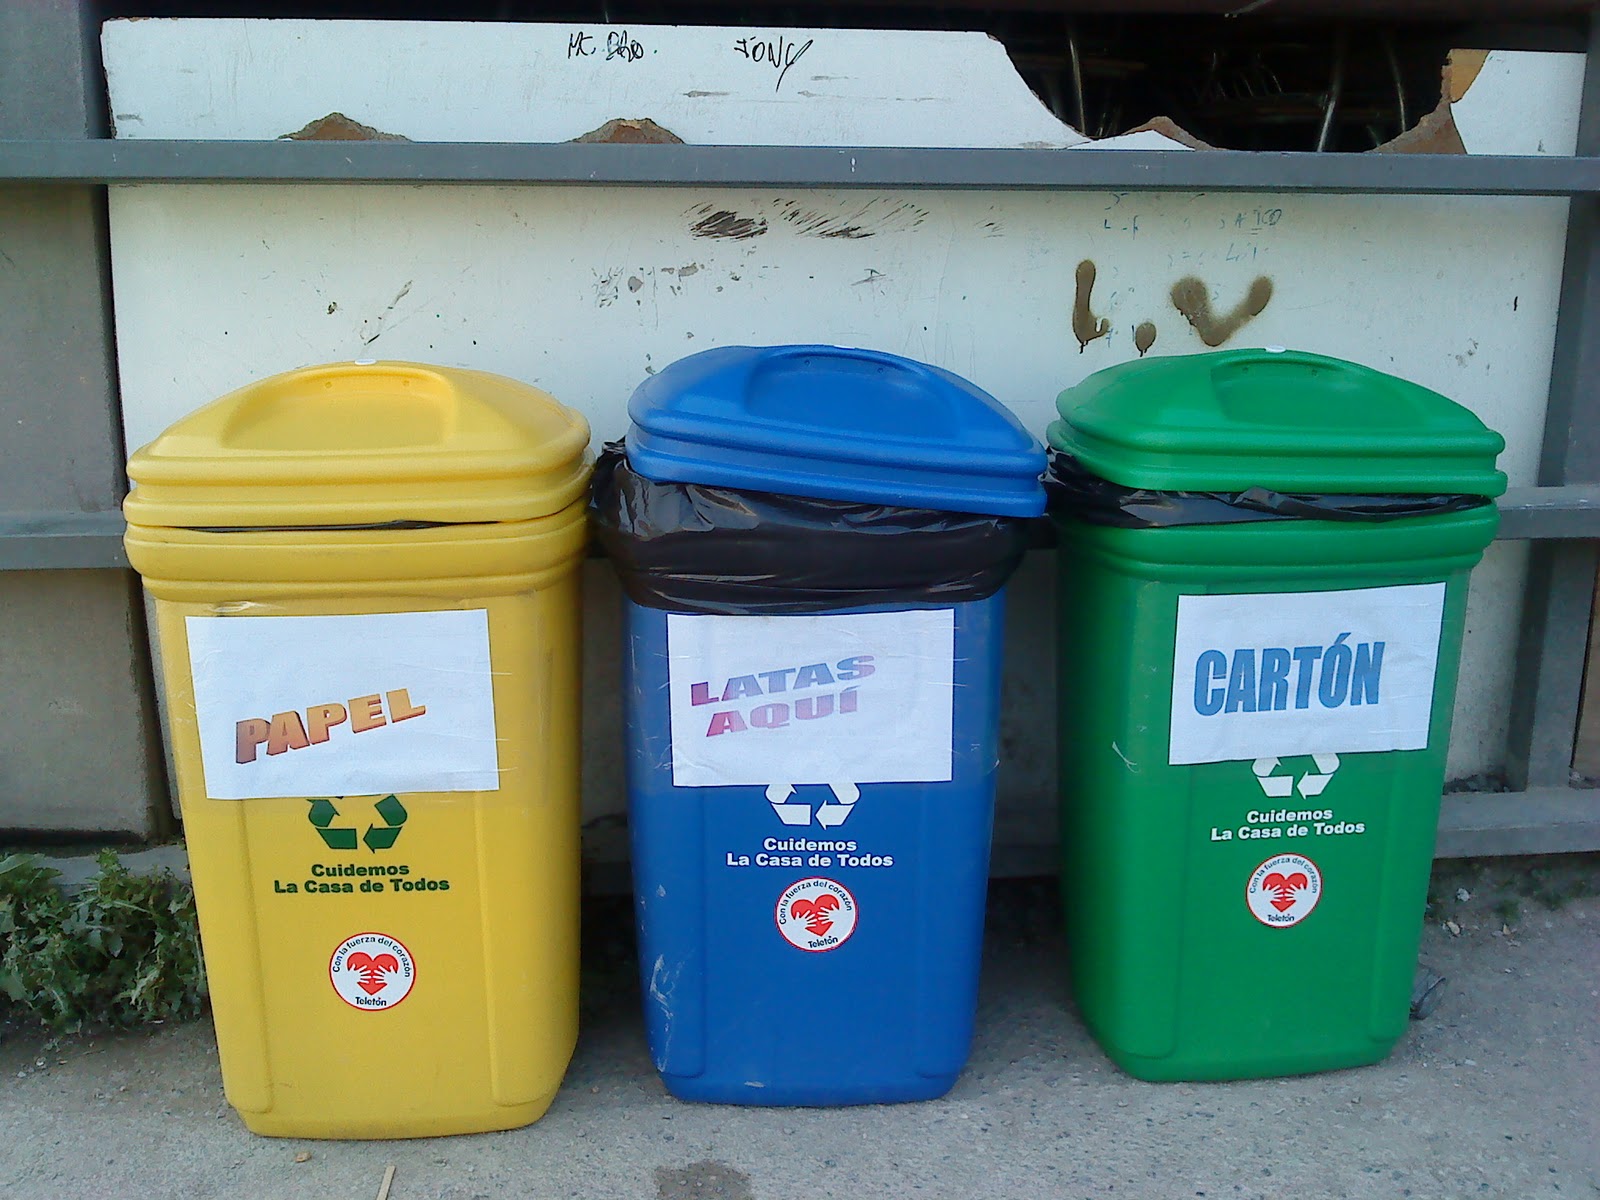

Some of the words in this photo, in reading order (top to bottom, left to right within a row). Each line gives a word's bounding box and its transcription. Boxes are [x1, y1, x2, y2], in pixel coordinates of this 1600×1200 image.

[690, 655, 876, 707] LATAS
[1193, 632, 1386, 717] CARTÓN
[706, 685, 861, 738] AQUÍ
[235, 688, 426, 764] PAPEL
[1246, 809, 1333, 823] Cuidemos
[1211, 828, 1232, 841] La
[1238, 826, 1282, 839] Casa
[1286, 824, 1308, 837] de
[1313, 821, 1365, 835] Todos
[763, 838, 857, 851] Cuidemos
[726, 853, 750, 866] La
[755, 854, 802, 866] Casa
[808, 855, 831, 867] de
[837, 854, 893, 867] Todos
[311, 864, 410, 877] Cuidemos
[1249, 876, 1260, 894] Con
[1264, 857, 1291, 870] fuerza
[1292, 857, 1306, 866] del
[1303, 863, 1319, 894] corazón
[274, 880, 298, 893] La
[304, 880, 353, 893] Casa
[360, 880, 384, 892] de
[390, 878, 450, 891] Todos
[785, 882, 812, 899] fuerza
[813, 880, 828, 888] del
[780, 899, 789, 907] la
[828, 883, 853, 911] corazón
[779, 908, 787, 925] Con
[1267, 913, 1295, 922] Teletón
[807, 935, 839, 948] Teletón
[332, 955, 343, 973] Con
[338, 946, 348, 956] la
[346, 936, 376, 949] fuerza
[377, 937, 393, 947] del
[392, 945, 412, 978] corazón
[355, 996, 387, 1006] Teletón
